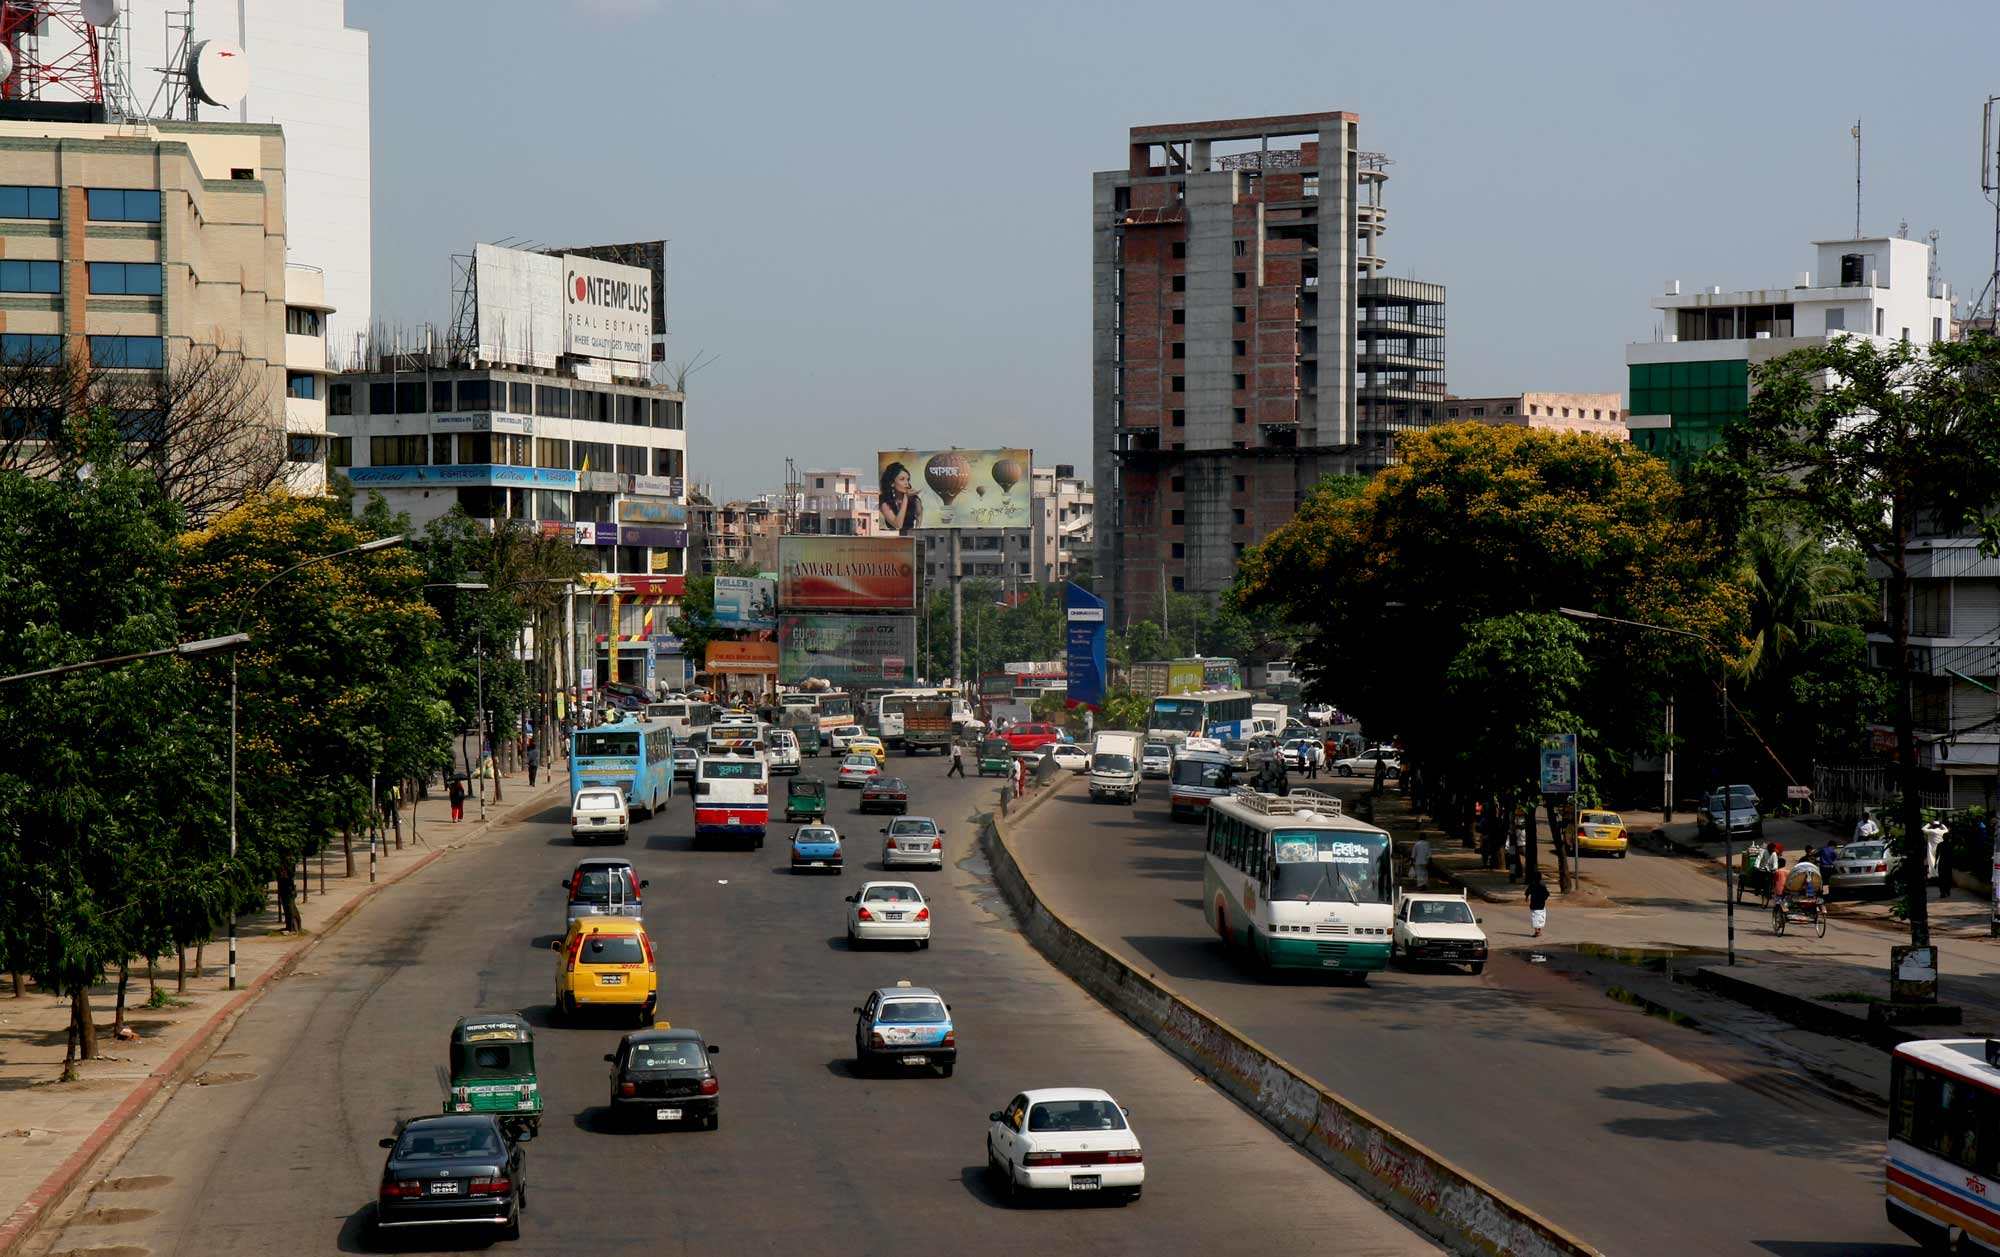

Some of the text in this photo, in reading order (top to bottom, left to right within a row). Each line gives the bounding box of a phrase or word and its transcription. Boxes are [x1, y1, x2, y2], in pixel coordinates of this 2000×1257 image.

[568, 270, 649, 314] CONTEMPLUS
[568, 313, 649, 337] REAL ESTATE
[795, 561, 898, 577] ANWAR LANDMARK
